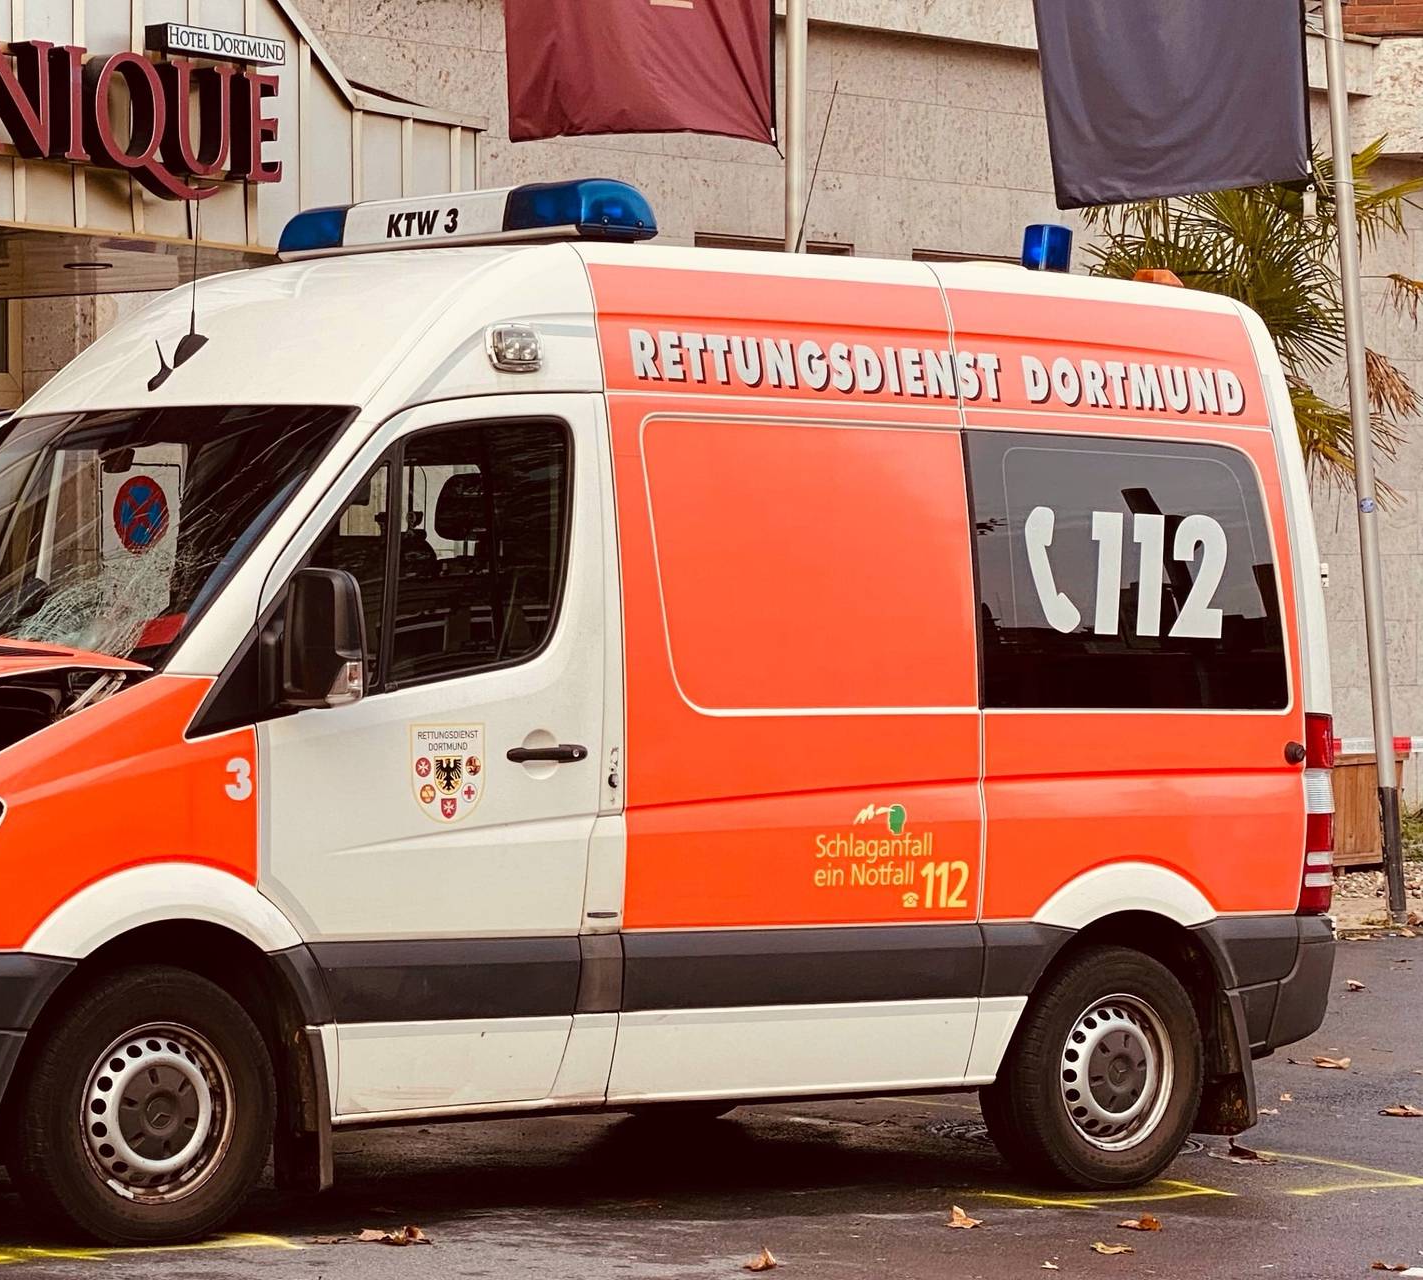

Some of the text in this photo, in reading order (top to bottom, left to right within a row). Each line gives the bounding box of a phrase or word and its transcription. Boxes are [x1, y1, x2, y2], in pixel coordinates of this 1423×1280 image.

[169, 26, 285, 61] HOTEL DORTMUND
[387, 208, 459, 239] KTW 3
[628, 328, 1246, 416] RETTUNGSDIENST DORTMUND
[1091, 510, 1228, 640] 112
[417, 729, 479, 740] RETTUNGSDIENST
[428, 741, 468, 752] DORTMUND
[224, 757, 253, 801] 3
[815, 832, 933, 863] Schlaganfall
[814, 860, 969, 909] ein Notfall 112
